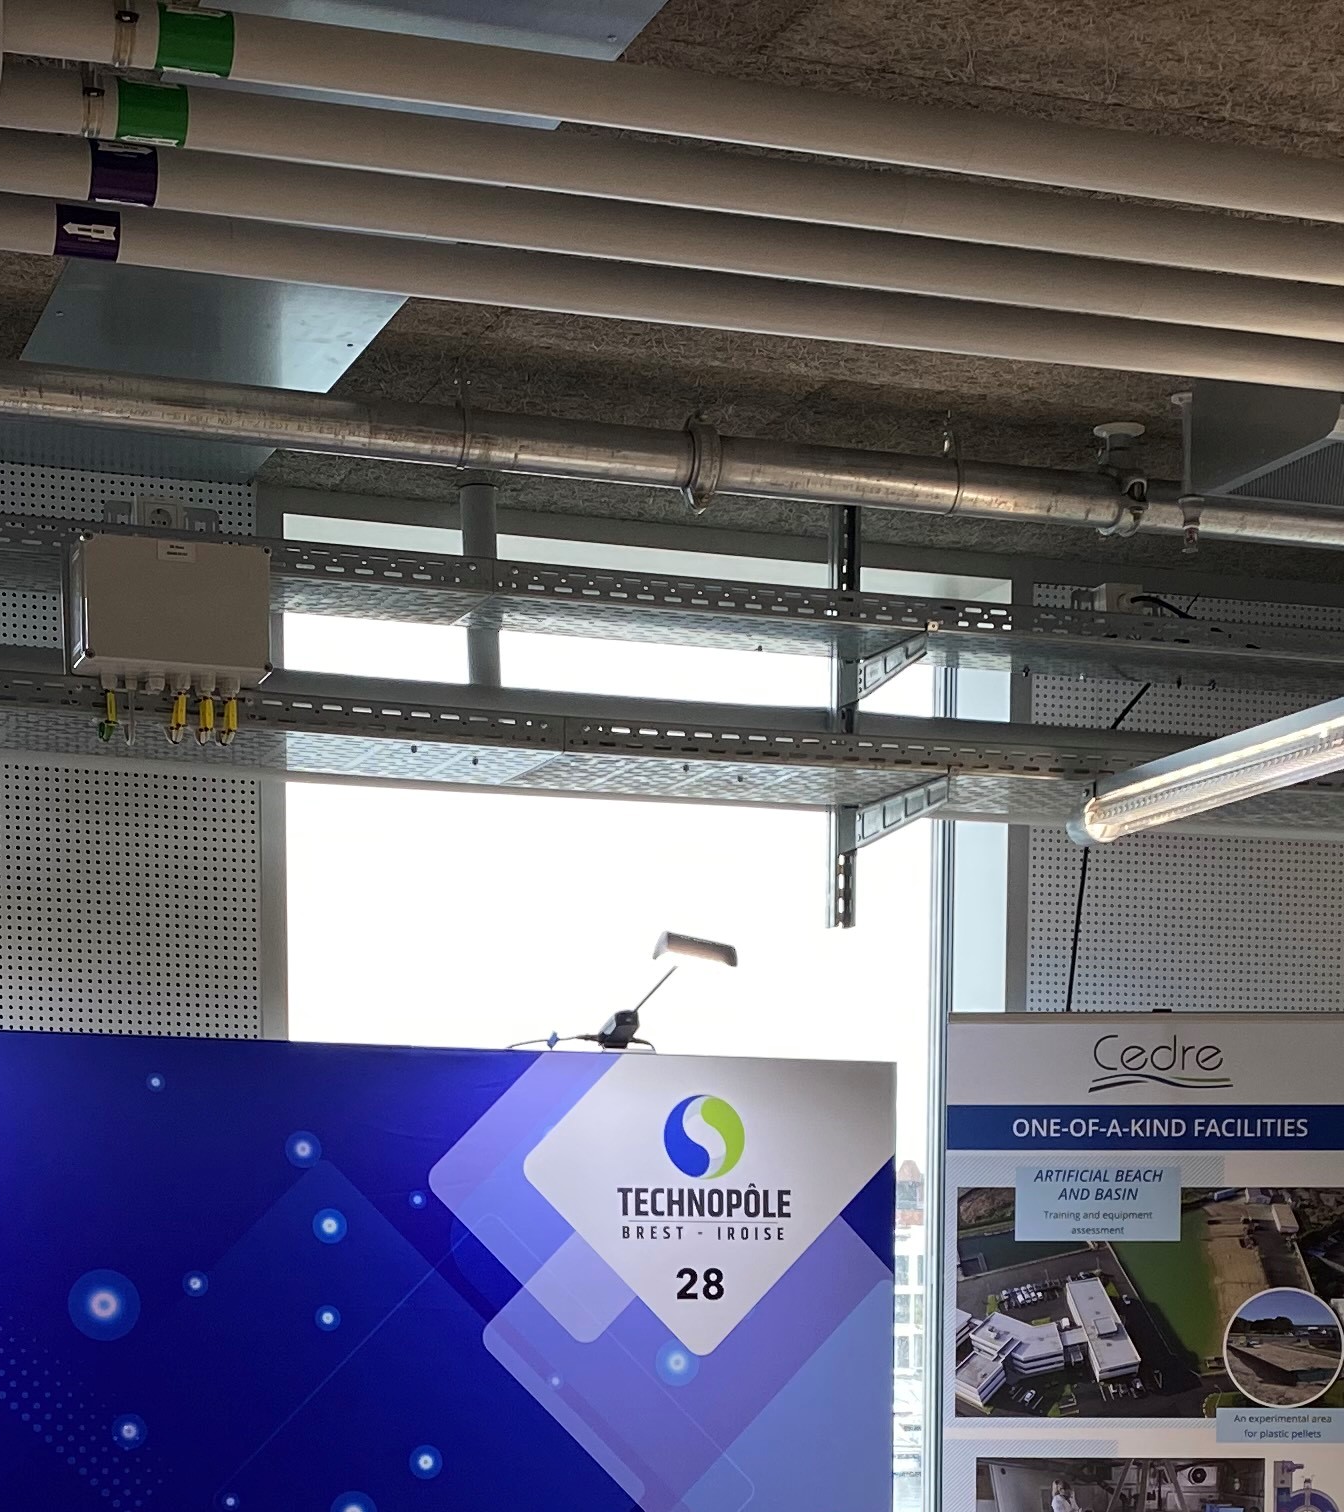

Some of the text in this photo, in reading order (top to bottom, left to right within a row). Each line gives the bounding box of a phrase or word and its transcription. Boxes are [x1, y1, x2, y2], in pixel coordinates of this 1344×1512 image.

[1094, 1034, 1223, 1071] Cedre
[1013, 1119, 1308, 1137] ONE-OF-A-KIND FACILITIES
[1033, 1169, 1163, 1182] ARTIFICIAL BEACH
[617, 1183, 791, 1218] TECHNOPÔLE
[1058, 1188, 1138, 1201] AND BASIN
[1043, 1210, 1153, 1222] Training and equipment
[622, 1226, 784, 1240] BREST IROISE
[1071, 1226, 1124, 1235] assessment
[676, 1268, 724, 1300] 28
[1234, 1414, 1247, 1422] An
[1249, 1414, 1309, 1427] experimental
[1244, 1429, 1322, 1440] for plastic pellets
